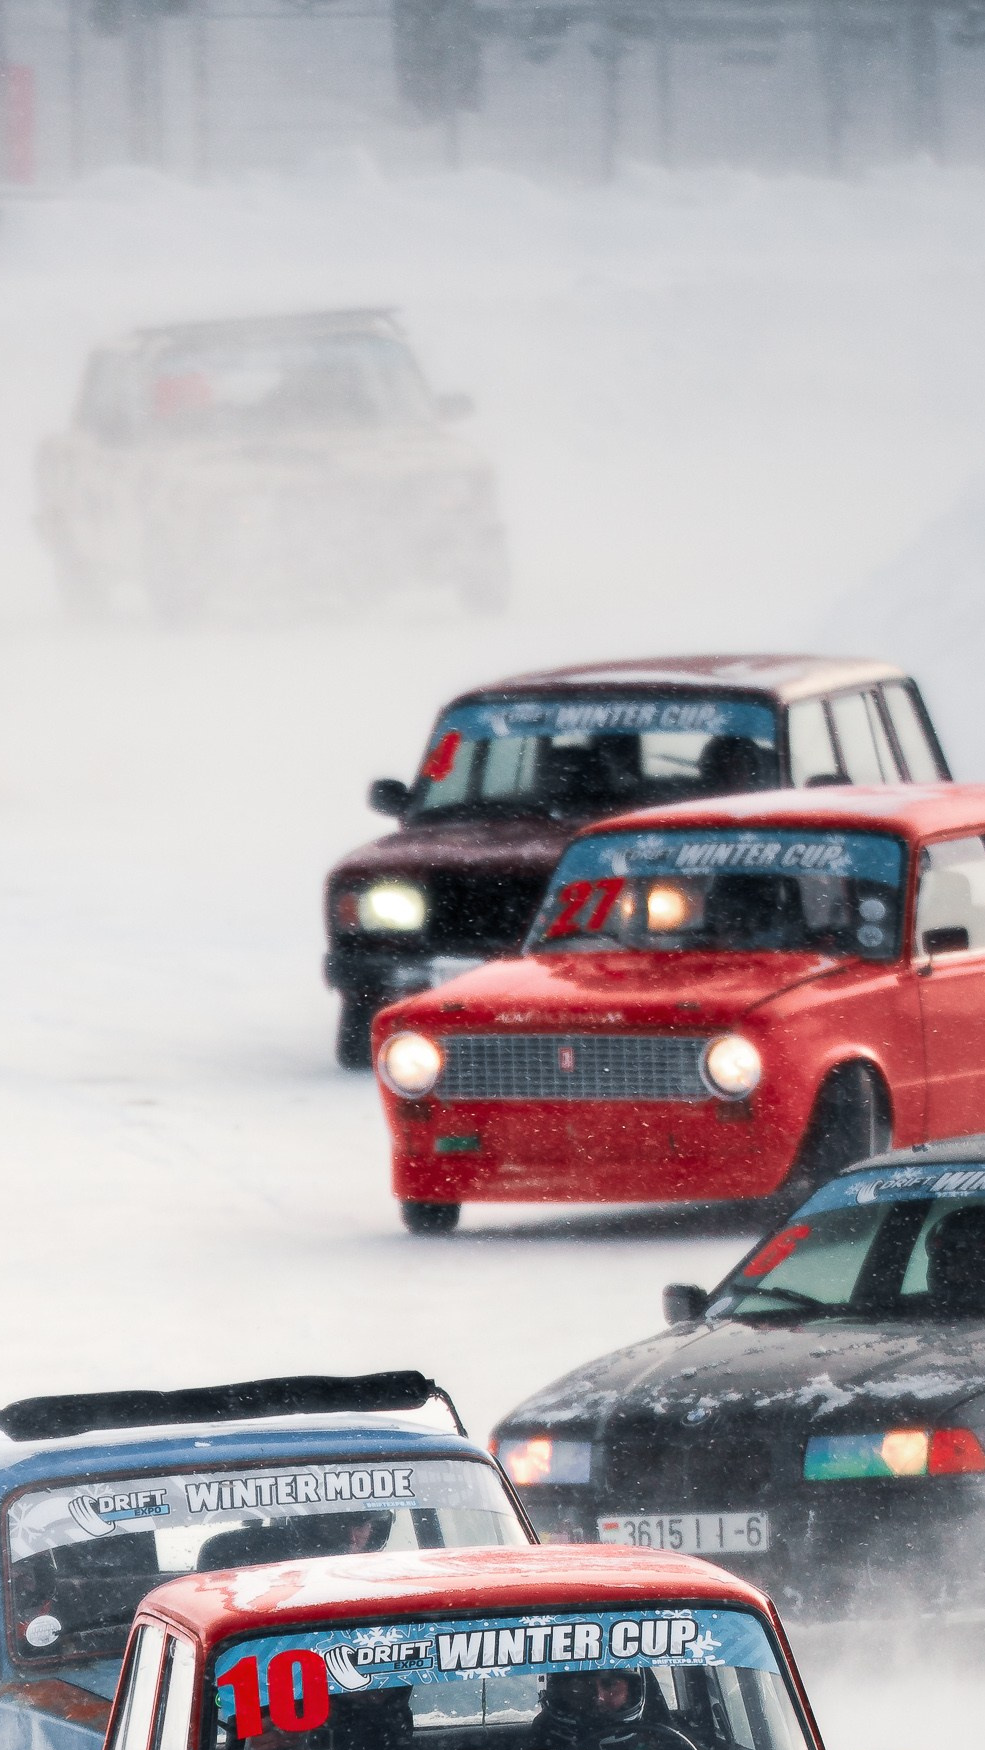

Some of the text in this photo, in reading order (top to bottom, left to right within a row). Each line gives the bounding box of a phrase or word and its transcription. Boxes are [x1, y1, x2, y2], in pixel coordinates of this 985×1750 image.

[675, 842, 782, 868] WINTER
[781, 842, 844, 868] CUP
[879, 1175, 938, 1190] DRIFT
[98, 1469, 415, 1514] DRIFT WINTER MODE
[134, 1506, 162, 1516] EXPO
[356, 1619, 698, 1672] DRIFT WINTER CUP
[394, 1659, 424, 1670] EXPO
[216, 1648, 330, 1740] 10
